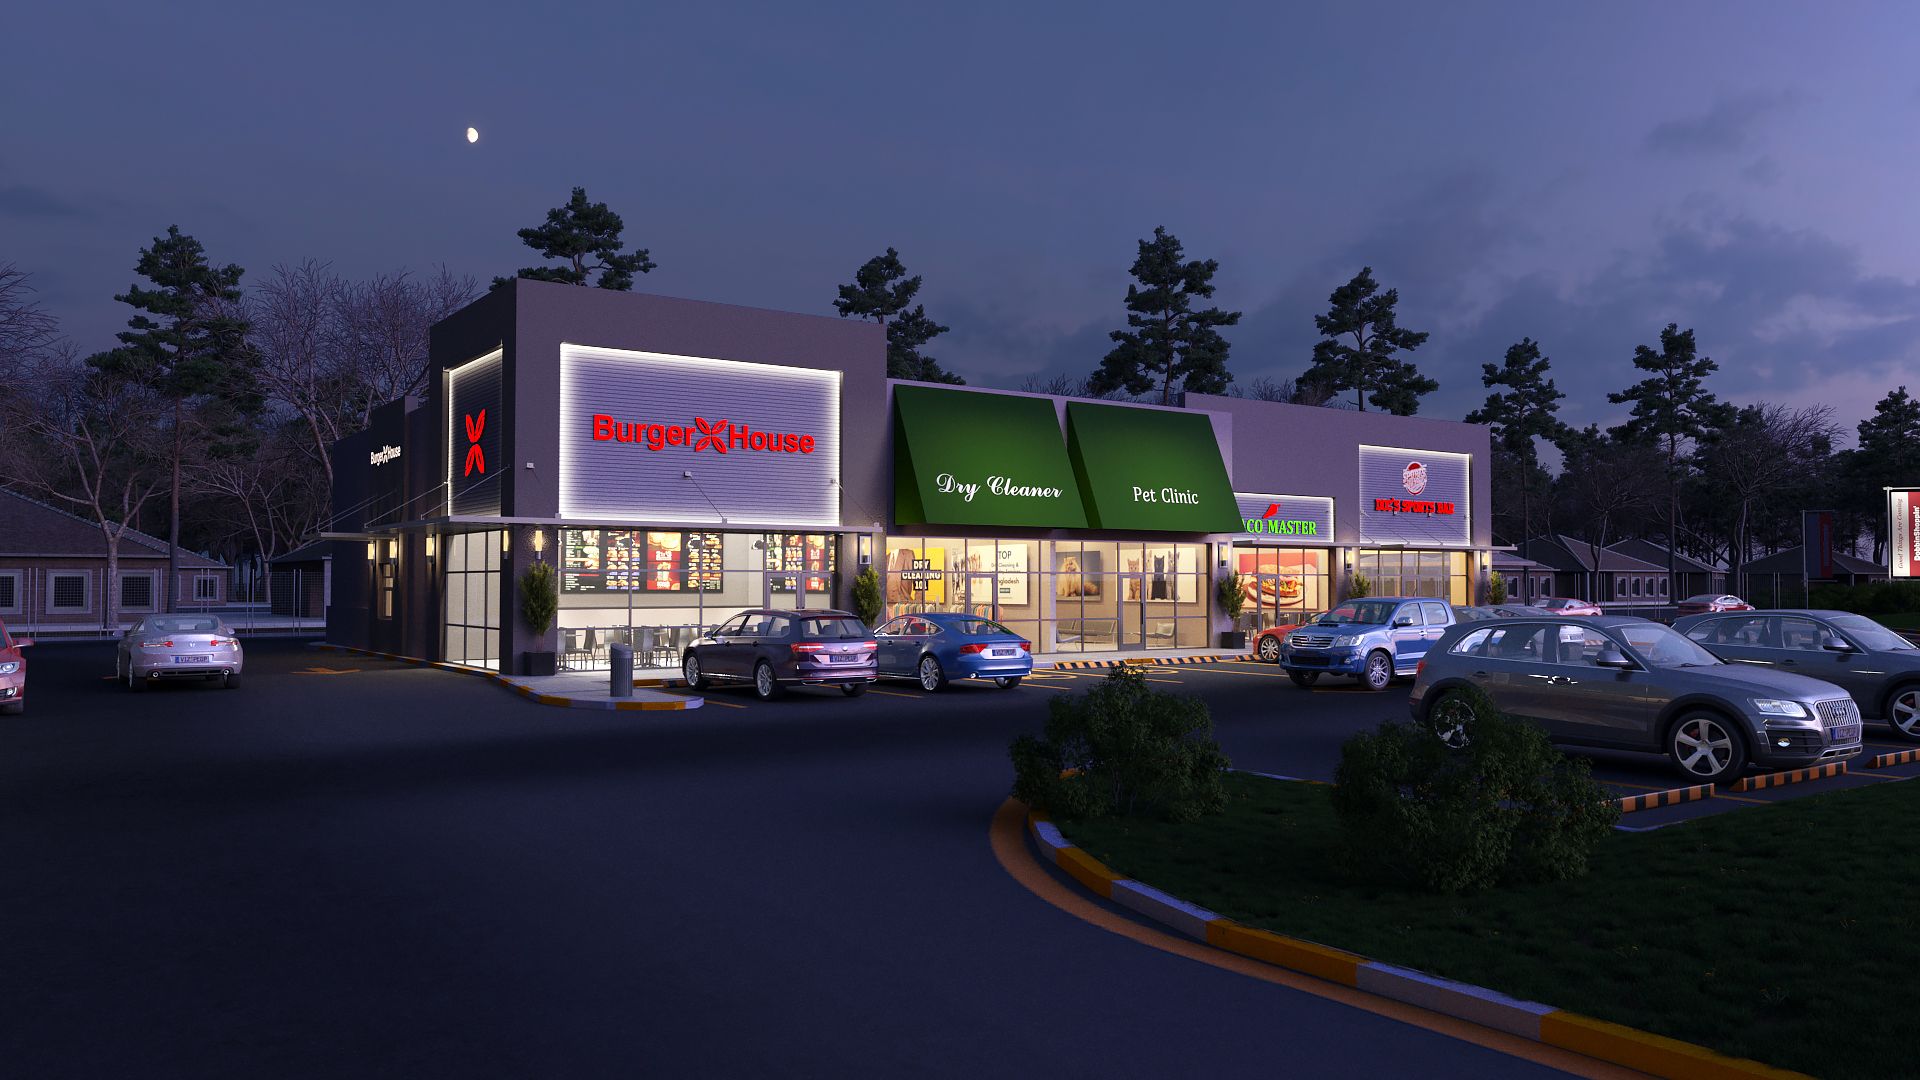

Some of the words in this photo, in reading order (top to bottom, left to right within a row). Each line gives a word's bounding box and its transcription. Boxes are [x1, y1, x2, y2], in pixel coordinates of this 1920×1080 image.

[592, 413, 697, 450] Burger
[729, 423, 815, 453] House
[936, 473, 981, 502] Dry
[986, 476, 1063, 498] Cleaner
[1132, 486, 1157, 502] Pet
[1161, 487, 1199, 504] Clinic
[1401, 499, 1435, 513] SPORTS
[1242, 518, 1263, 534] CO
[1267, 519, 1317, 535] MASTER
